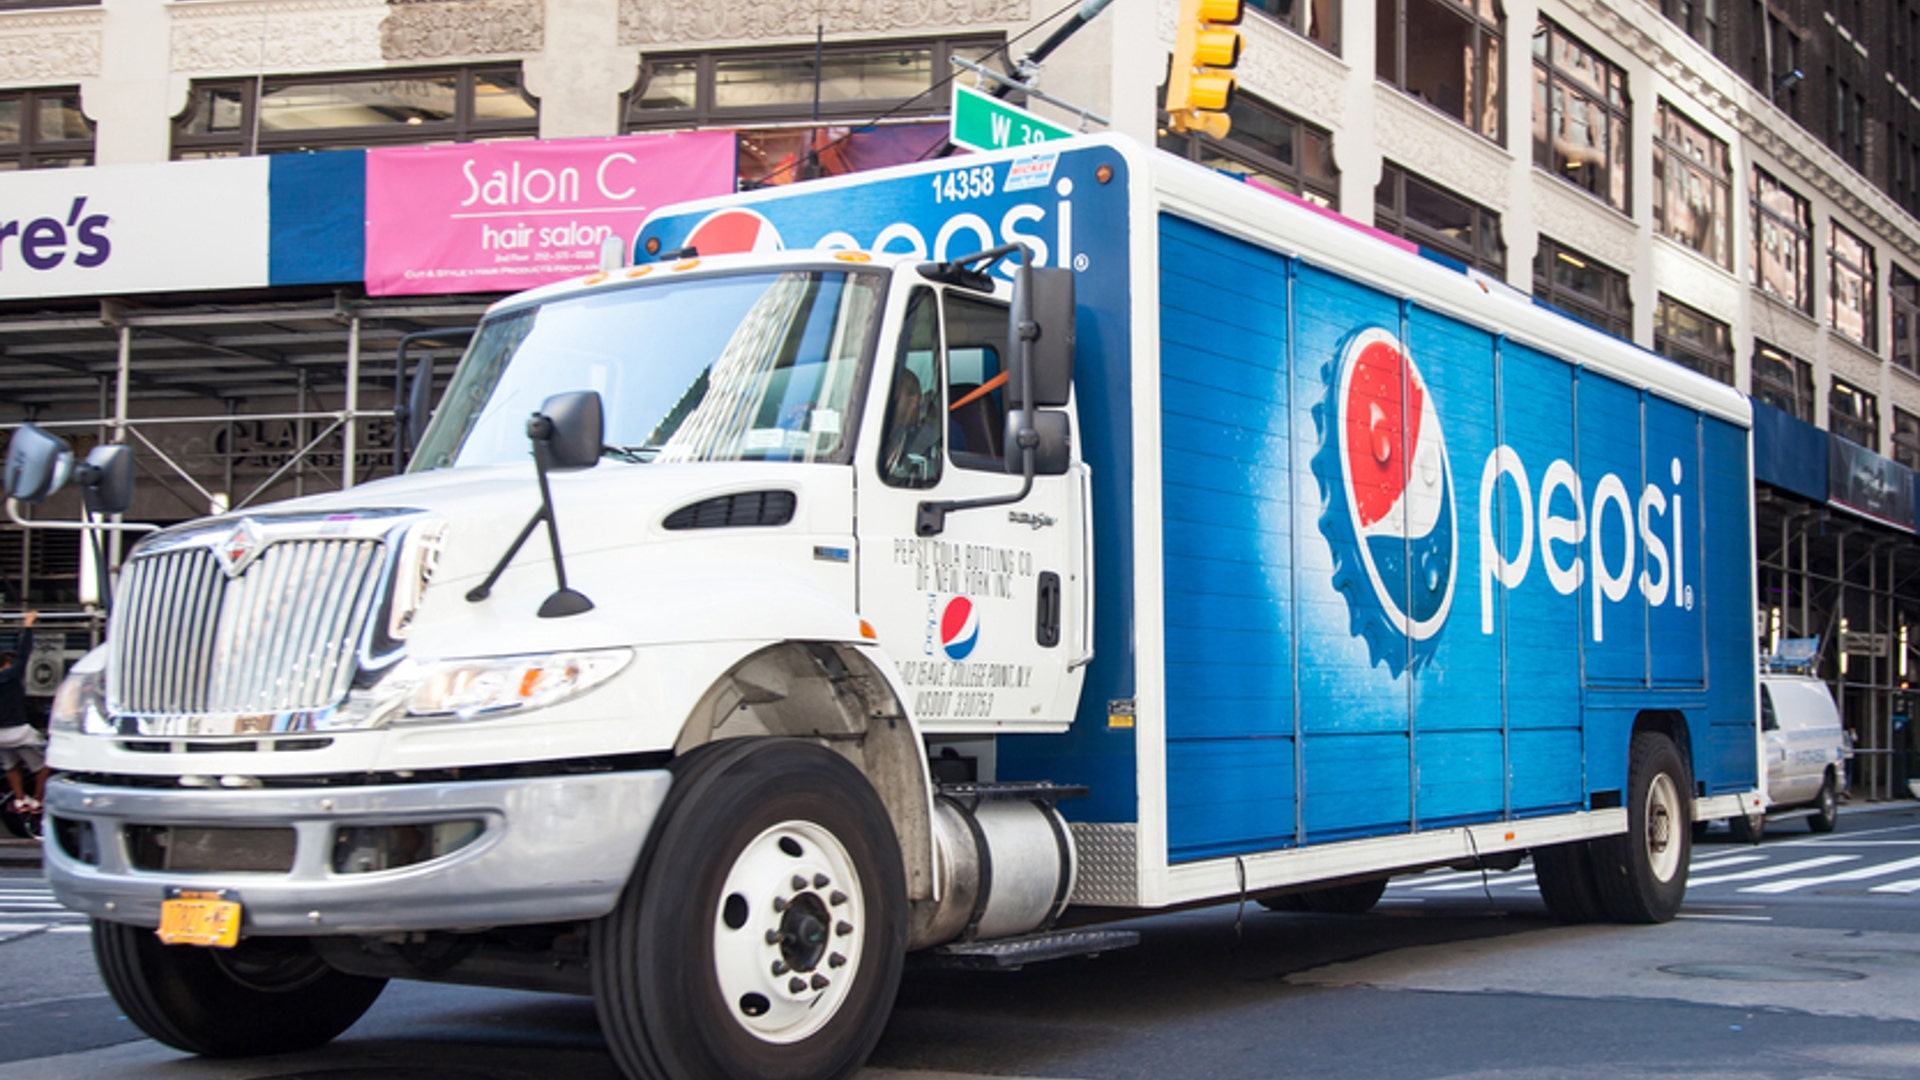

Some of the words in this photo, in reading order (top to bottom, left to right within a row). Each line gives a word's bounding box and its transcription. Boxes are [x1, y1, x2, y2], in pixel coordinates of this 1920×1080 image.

[991, 112, 1012, 148] W
[461, 159, 579, 206] Salon
[597, 152, 637, 200] C
[932, 165, 995, 204] 14358
[482, 223, 533, 250] hair
[539, 221, 612, 247] salon
[813, 176, 1073, 278] esi
[894, 538, 928, 565] PEPSI
[965, 543, 1014, 574] BOTTLING
[1479, 444, 1684, 643] pepsi
[934, 564, 959, 593] NEW
[963, 569, 990, 596] YORK
[949, 661, 987, 688] COLLEGE
[915, 690, 953, 717] USDOT
